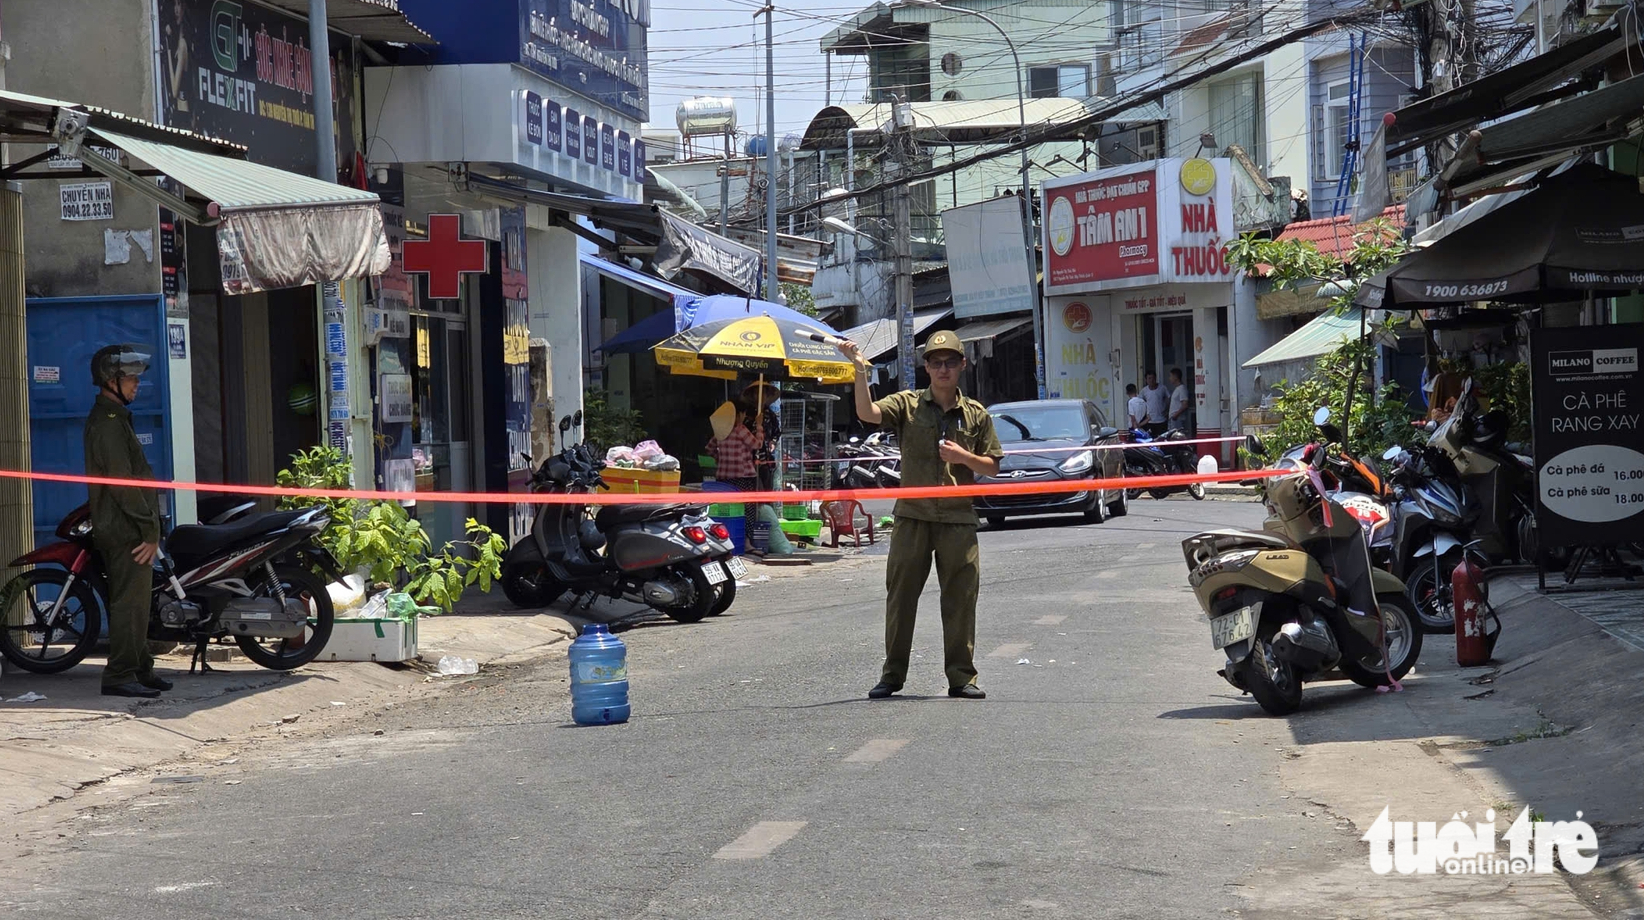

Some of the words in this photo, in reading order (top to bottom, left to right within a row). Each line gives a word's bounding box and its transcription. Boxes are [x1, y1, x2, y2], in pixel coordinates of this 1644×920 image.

[255, 22, 275, 84] SỨC
[294, 36, 313, 104] CỘN
[198, 66, 256, 115] FLEXFIT
[1075, 189, 1088, 204] NHÀ
[1088, 184, 1107, 201] THUỐC
[1106, 185, 1119, 201] ĐẠT
[1118, 176, 1138, 197] CHUẨN
[1137, 179, 1150, 194] GPP
[62, 202, 112, 218] 0904.22.33.50
[1181, 197, 1218, 233] NHÀ
[1077, 205, 1114, 247] TÂM
[1171, 235, 1231, 276] THUỐC
[1425, 284, 1459, 298] 1900
[1459, 280, 1508, 297] 636873
[1569, 271, 1611, 283] Hotline
[1613, 271, 1644, 286] nhượ
[1062, 337, 1096, 366] NHÀ
[1552, 357, 1591, 368] MILANO
[1596, 355, 1636, 366] COFFEE
[1556, 373, 1633, 383] www.milanocoffee.com.vn
[1563, 390, 1591, 411] CÀ
[1595, 389, 1628, 409] PHÊ
[1552, 415, 1604, 433] RANG
[1608, 413, 1641, 430] XAY
[1547, 466, 1563, 476] Cà
[1566, 464, 1587, 477] phê
[1589, 463, 1605, 474] đá
[1614, 470, 1644, 481] 16.00
[1547, 487, 1563, 498] Cà
[1567, 487, 1588, 499] phê
[1591, 486, 1611, 496] sữa
[1216, 611, 1245, 633] 72-C1
[1215, 623, 1252, 649] 676.42
